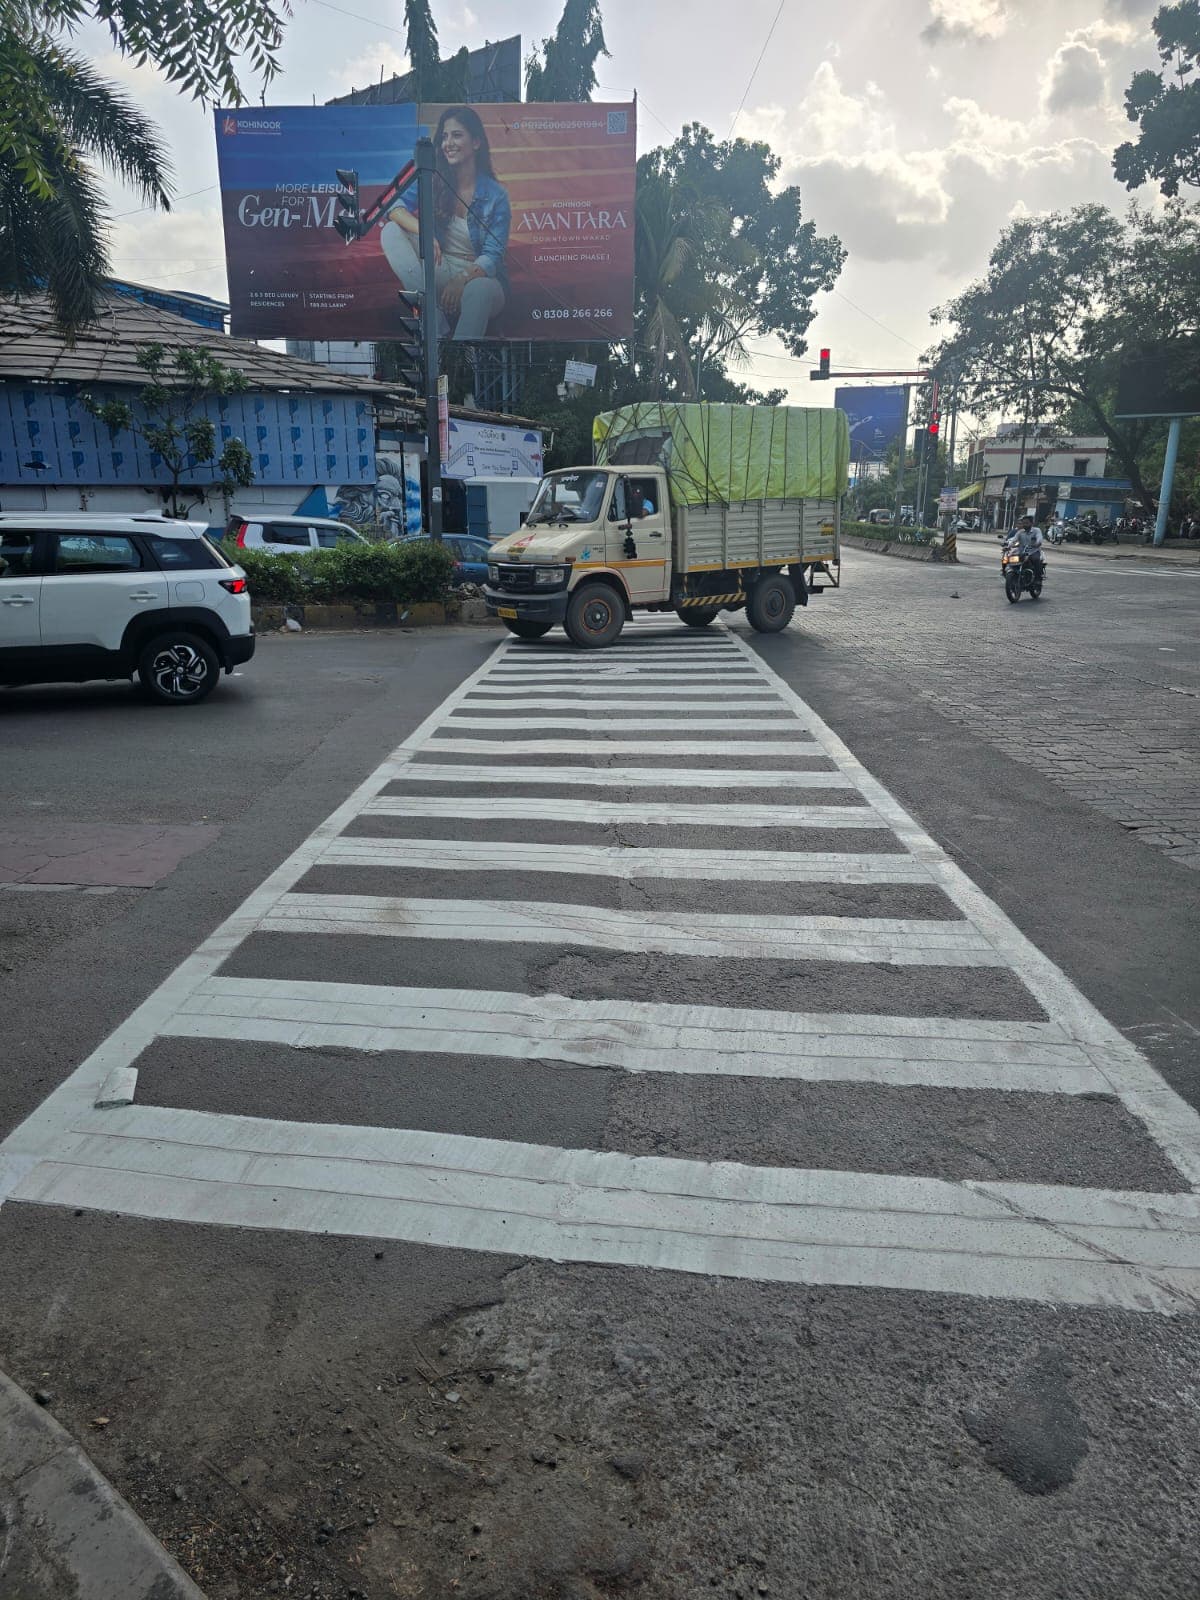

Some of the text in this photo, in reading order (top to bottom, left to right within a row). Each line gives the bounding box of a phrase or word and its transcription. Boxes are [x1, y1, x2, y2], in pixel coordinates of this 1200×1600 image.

[237, 120, 281, 129] KOHINOOR
[275, 183, 357, 194] MORE LEISU
[281, 196, 305, 206] FOR
[552, 200, 592, 208] KOHINOOR
[517, 210, 627, 231] AVANTARA
[534, 254, 579, 262] LAUNCHING
[580, 253, 605, 261] PHASE
[543, 308, 613, 319] 8308 266 266
